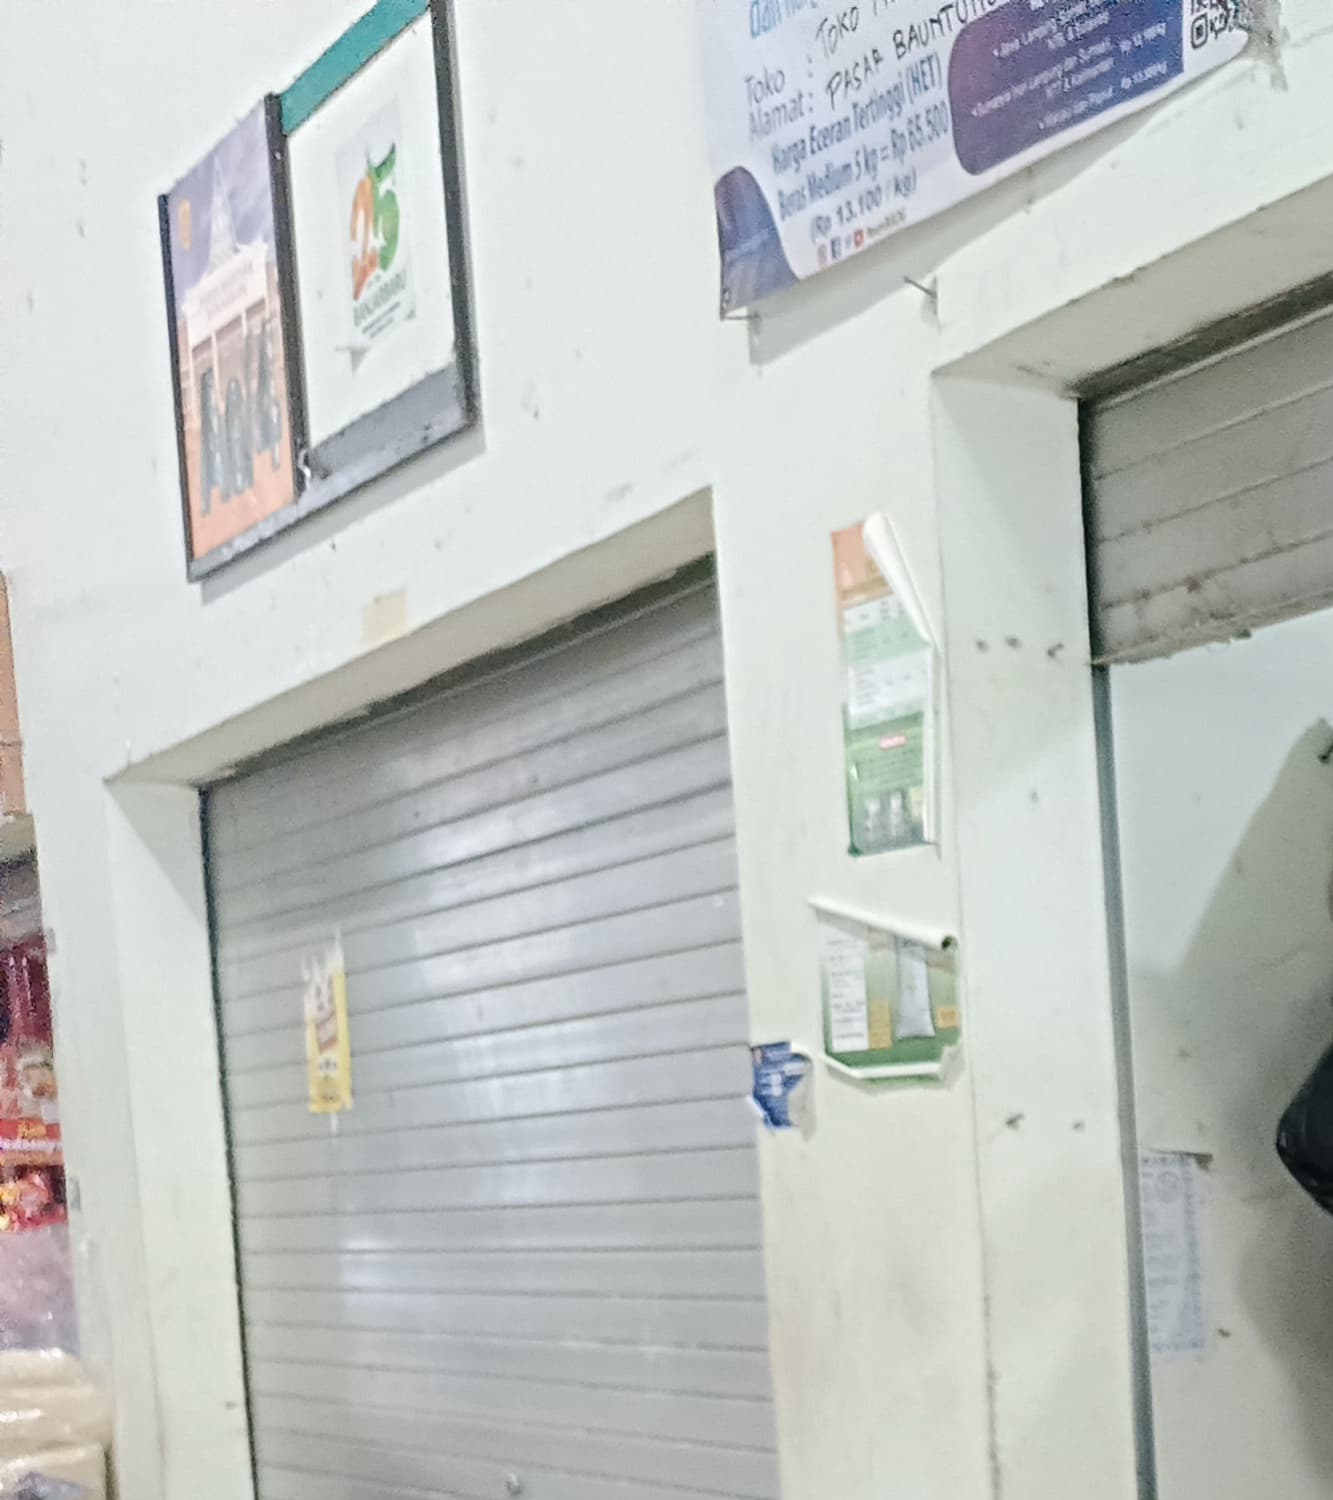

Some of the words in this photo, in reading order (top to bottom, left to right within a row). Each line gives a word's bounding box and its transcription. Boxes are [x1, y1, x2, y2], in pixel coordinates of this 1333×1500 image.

[815, 6, 859, 60] TOKO
[808, 116, 851, 155] Eceran
[905, 52, 943, 104] (HET)
[826, 49, 884, 110] PASAR
